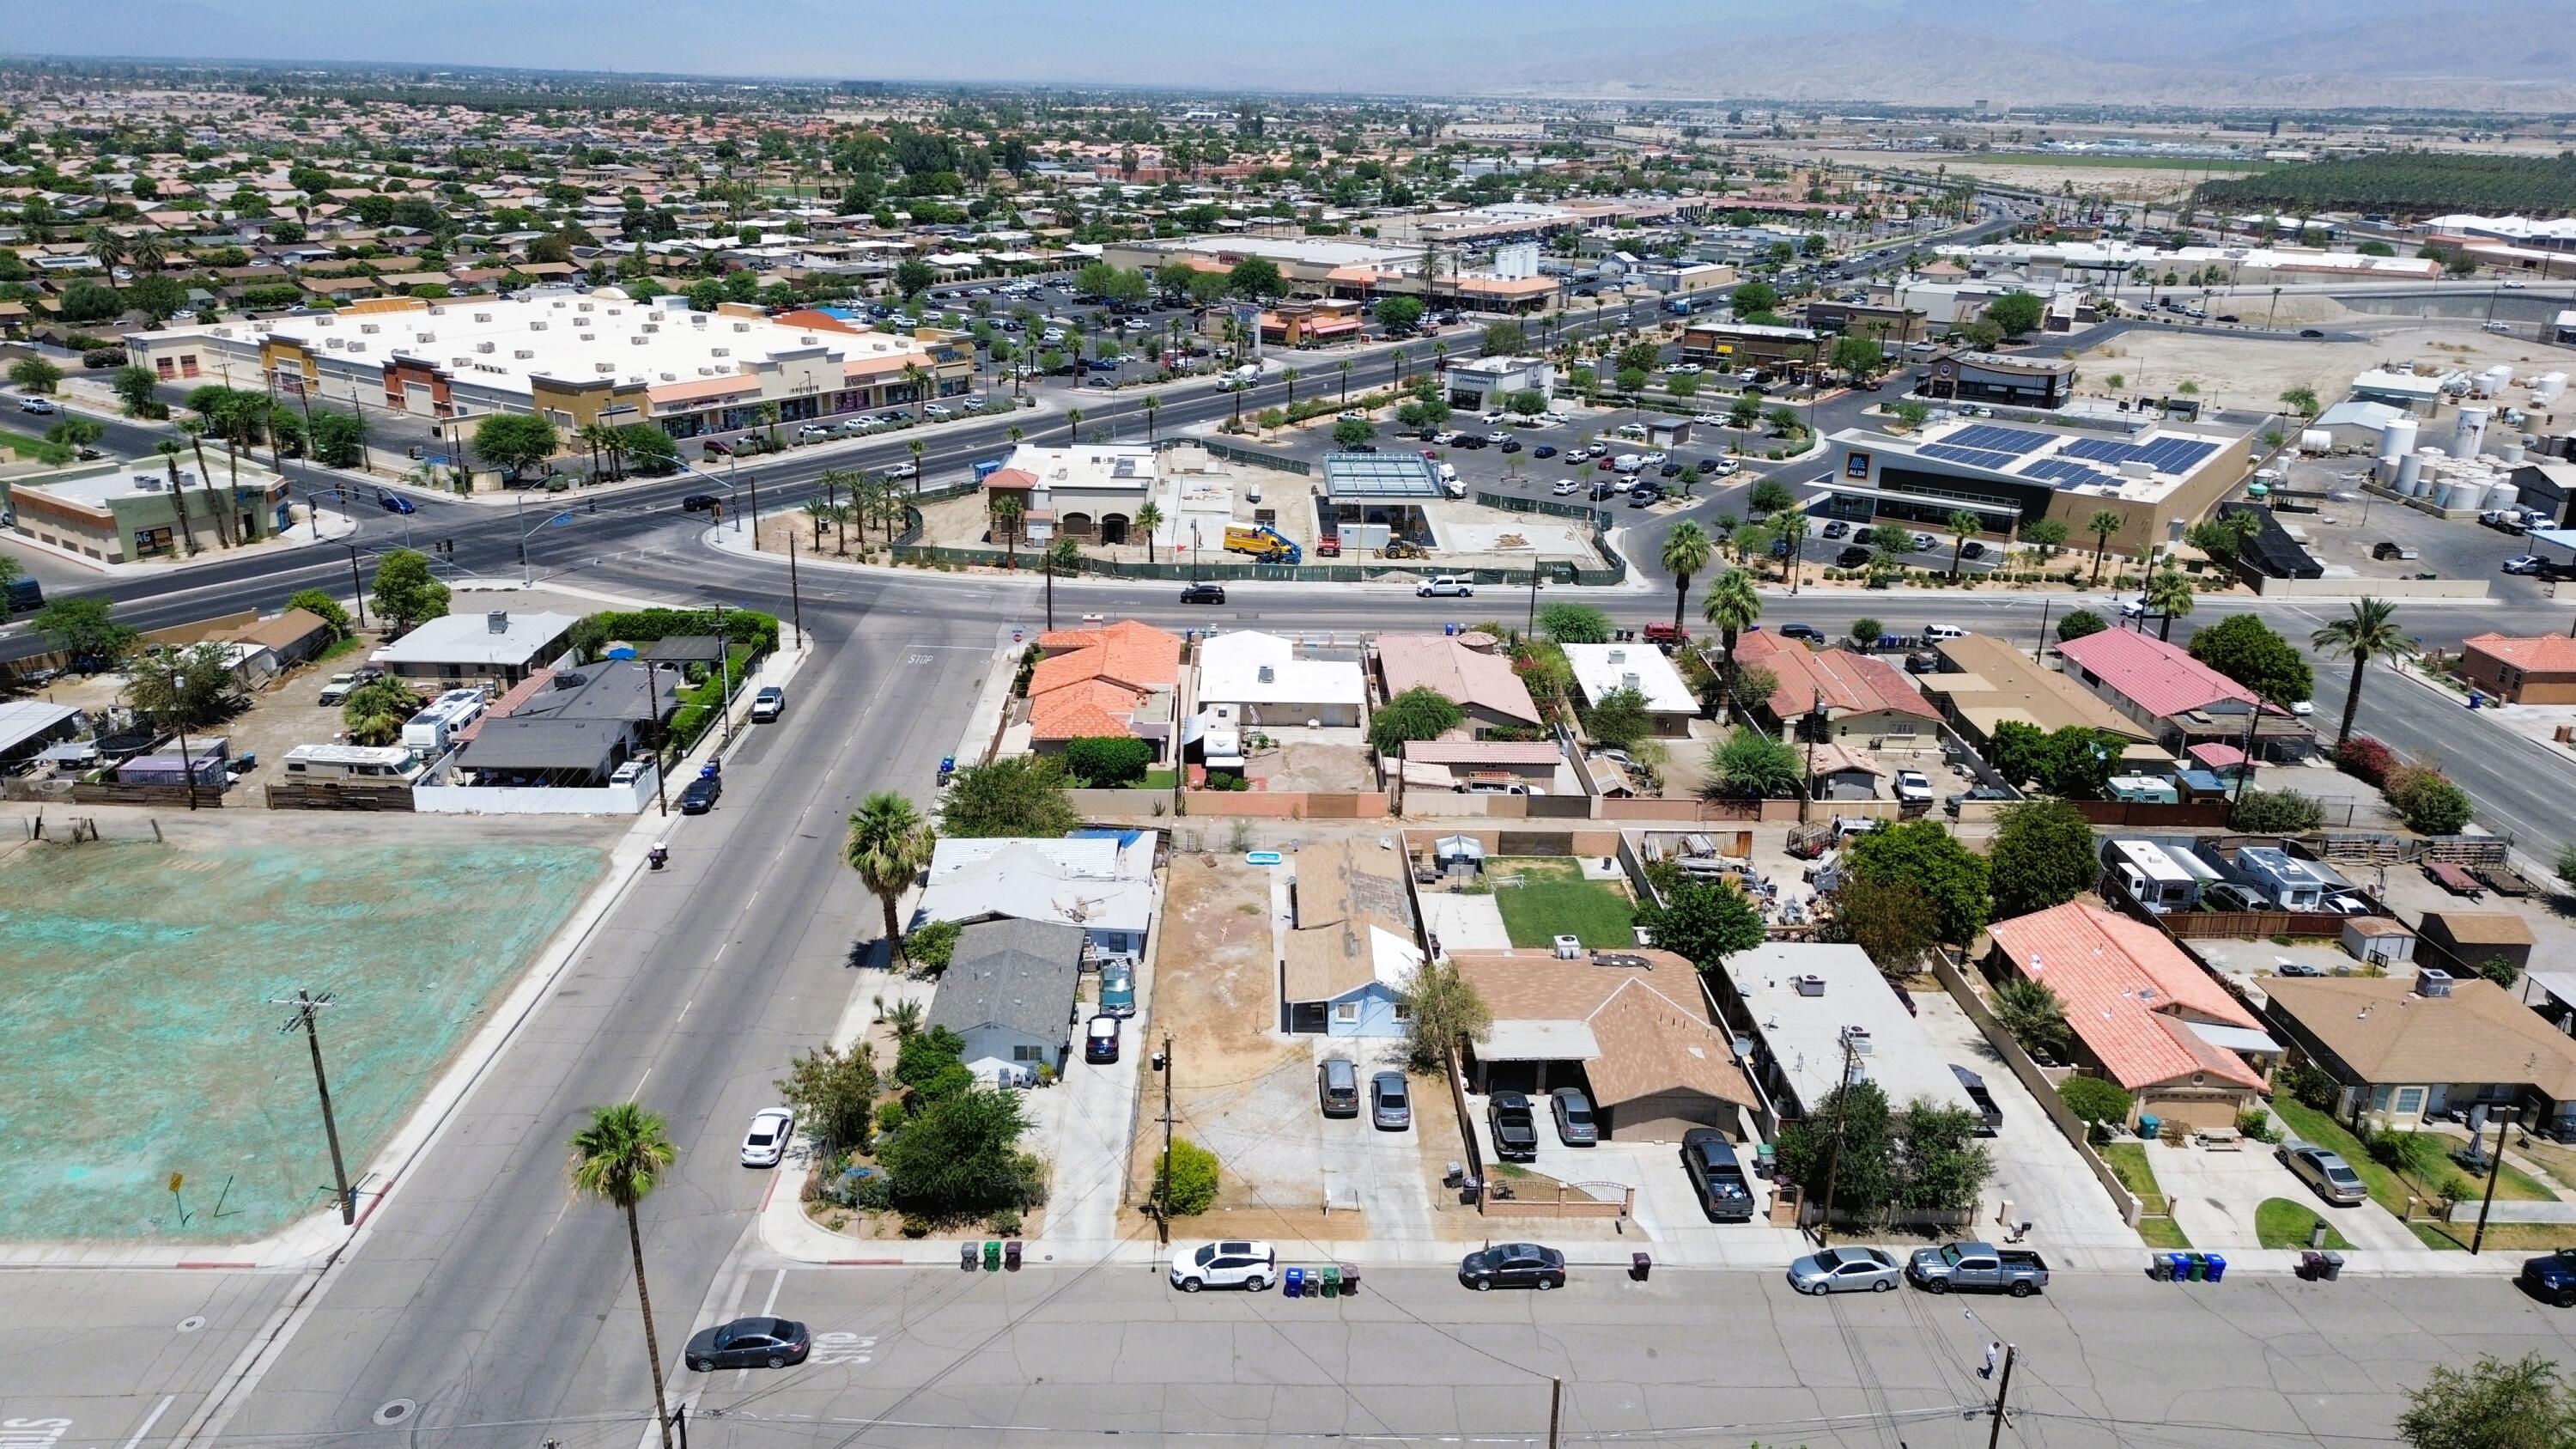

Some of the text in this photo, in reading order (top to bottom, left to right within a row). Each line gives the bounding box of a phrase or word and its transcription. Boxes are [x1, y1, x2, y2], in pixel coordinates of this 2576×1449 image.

[1460, 374, 1489, 383] STARBUCKS
[1848, 469, 1866, 478] ALDI
[908, 654, 934, 665] STOP
[807, 1332, 878, 1364] STOP
